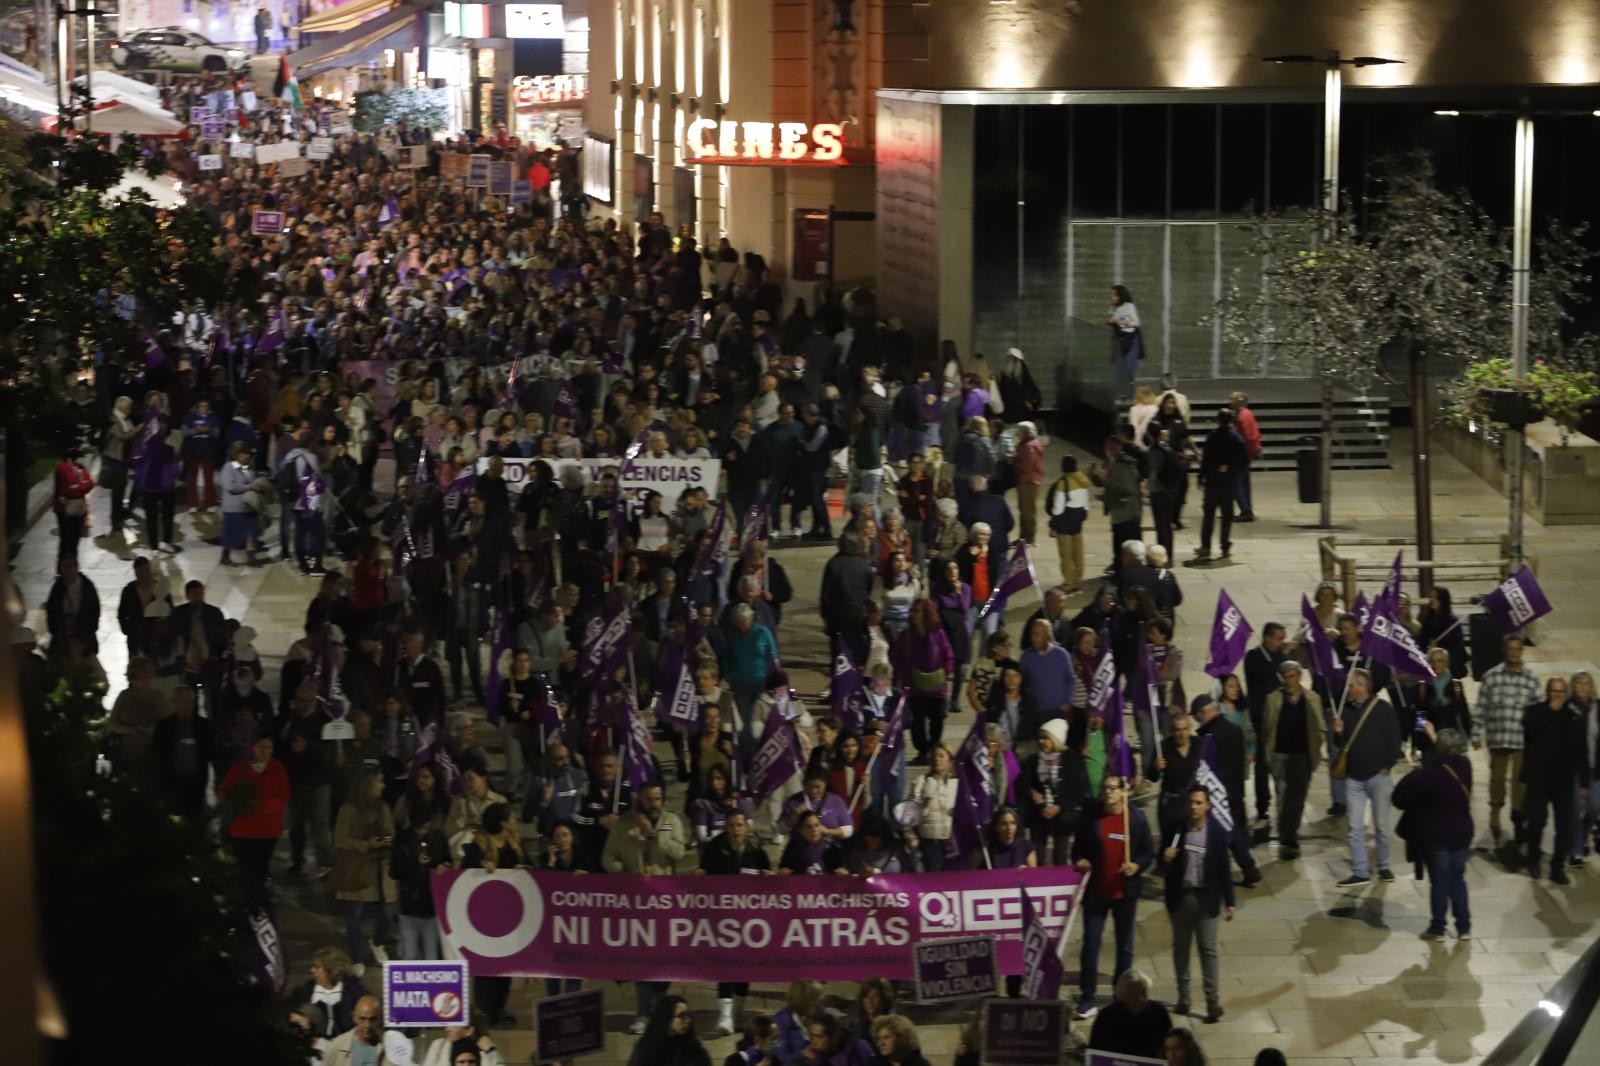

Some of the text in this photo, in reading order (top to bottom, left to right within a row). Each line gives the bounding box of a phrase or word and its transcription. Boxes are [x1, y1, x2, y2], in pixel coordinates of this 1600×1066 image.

[687, 119, 843, 163] CINES
[551, 891, 910, 909] CONTRA LAS VIOLENCIAS MACHISTAS
[552, 909, 910, 949] NI UN PASO ATRÁS
[920, 941, 989, 963] IGUALDAD
[392, 970, 460, 984] EL MACHISMO
[944, 962, 968, 978] SIN
[923, 974, 992, 998] VIOLENCIA
[392, 990, 431, 1008] MATA
